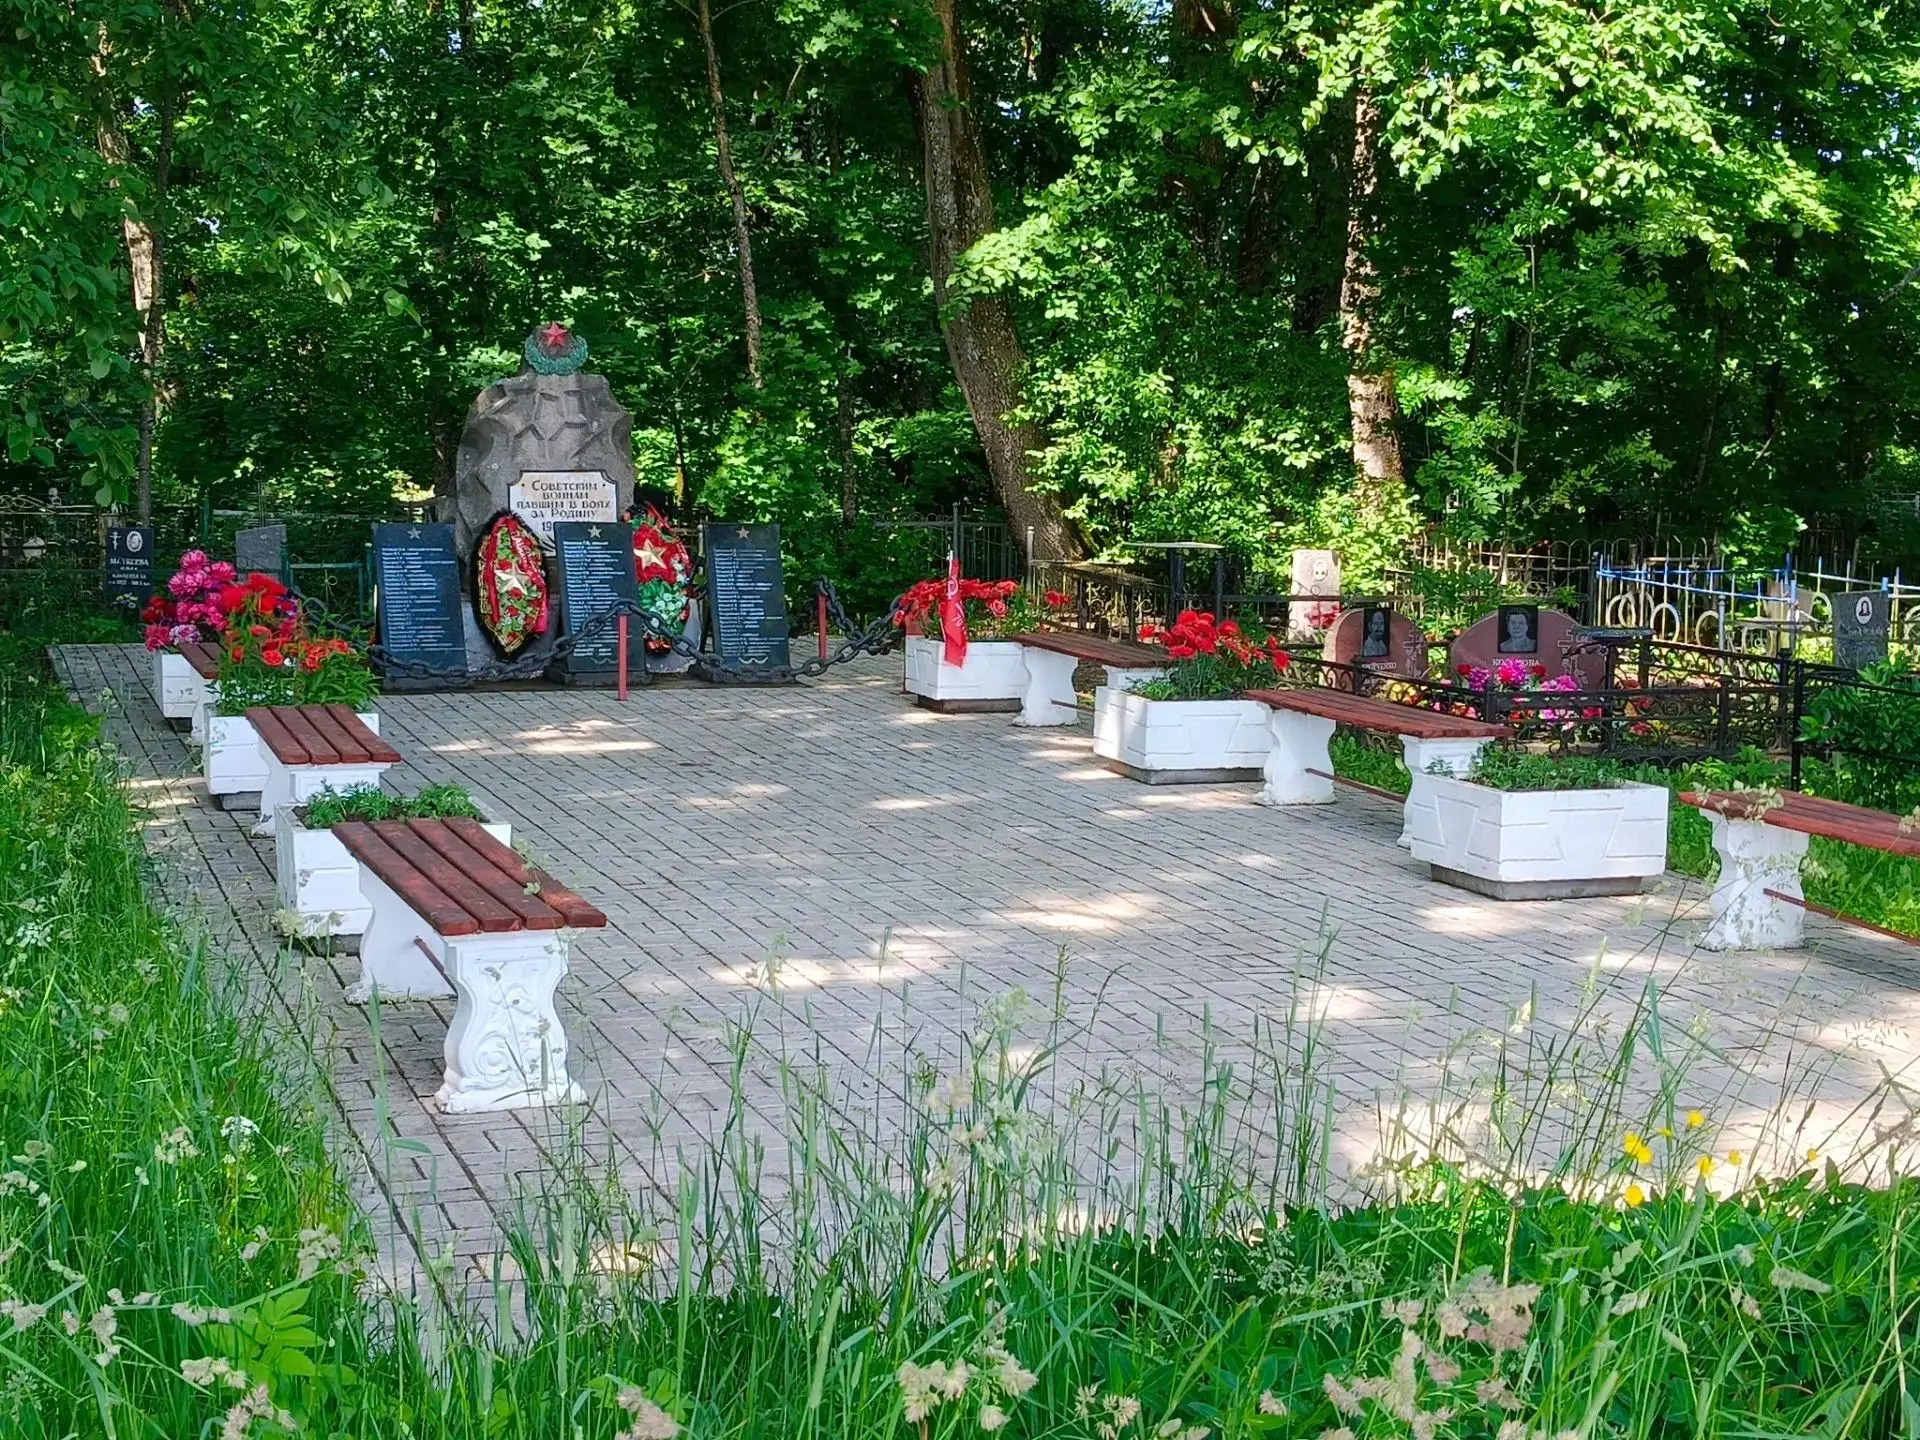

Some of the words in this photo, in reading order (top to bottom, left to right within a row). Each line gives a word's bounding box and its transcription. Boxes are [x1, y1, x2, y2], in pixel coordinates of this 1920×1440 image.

[532, 480, 597, 491] СОВЕТСКИМ
[542, 492, 589, 500] ВОИНАМ
[517, 500, 564, 509] ПАВШИМ
[569, 500, 577, 509] В
[582, 500, 610, 509] БОЯХ
[531, 510, 544, 519] ЗА
[551, 509, 597, 519] РОДИНУ
